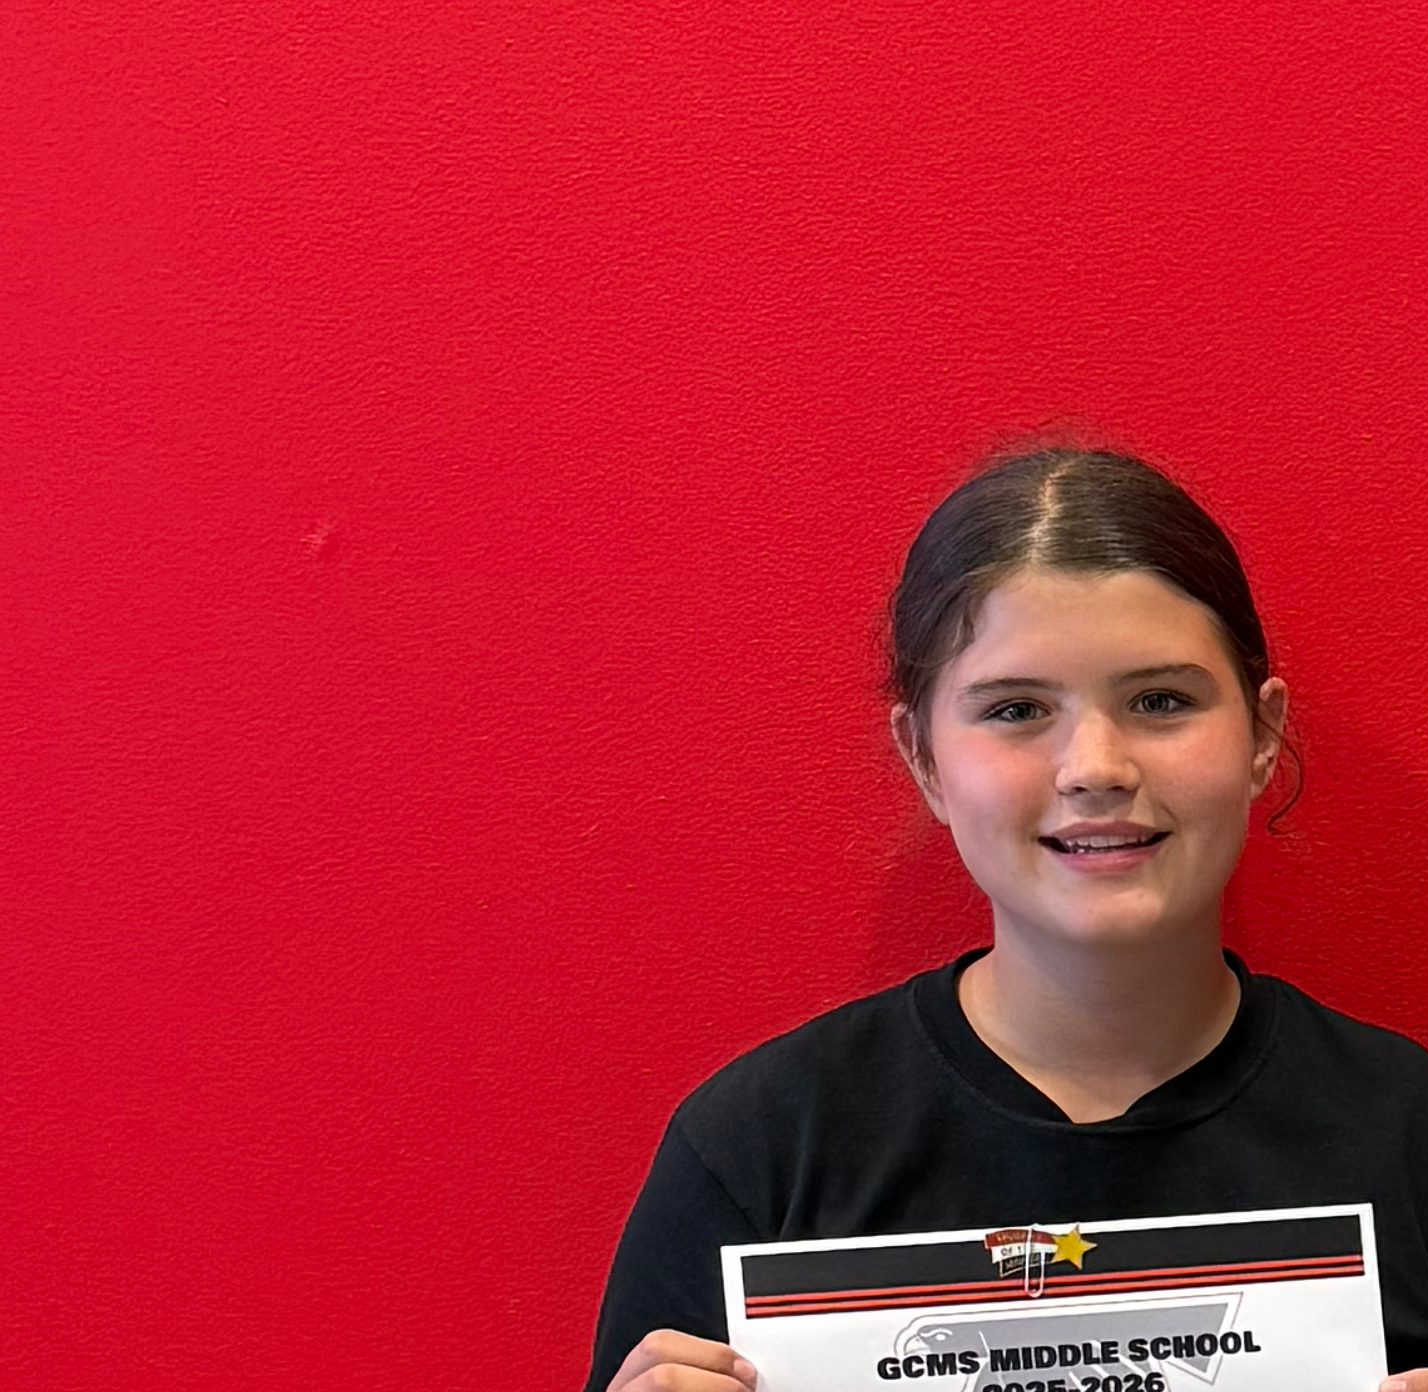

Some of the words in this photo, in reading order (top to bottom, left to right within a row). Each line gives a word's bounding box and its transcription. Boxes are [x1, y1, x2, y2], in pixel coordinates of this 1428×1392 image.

[877, 1350, 980, 1380] GCMS
[989, 1340, 1120, 1373] MIDDLE
[1127, 1330, 1261, 1362] SCHOOL
